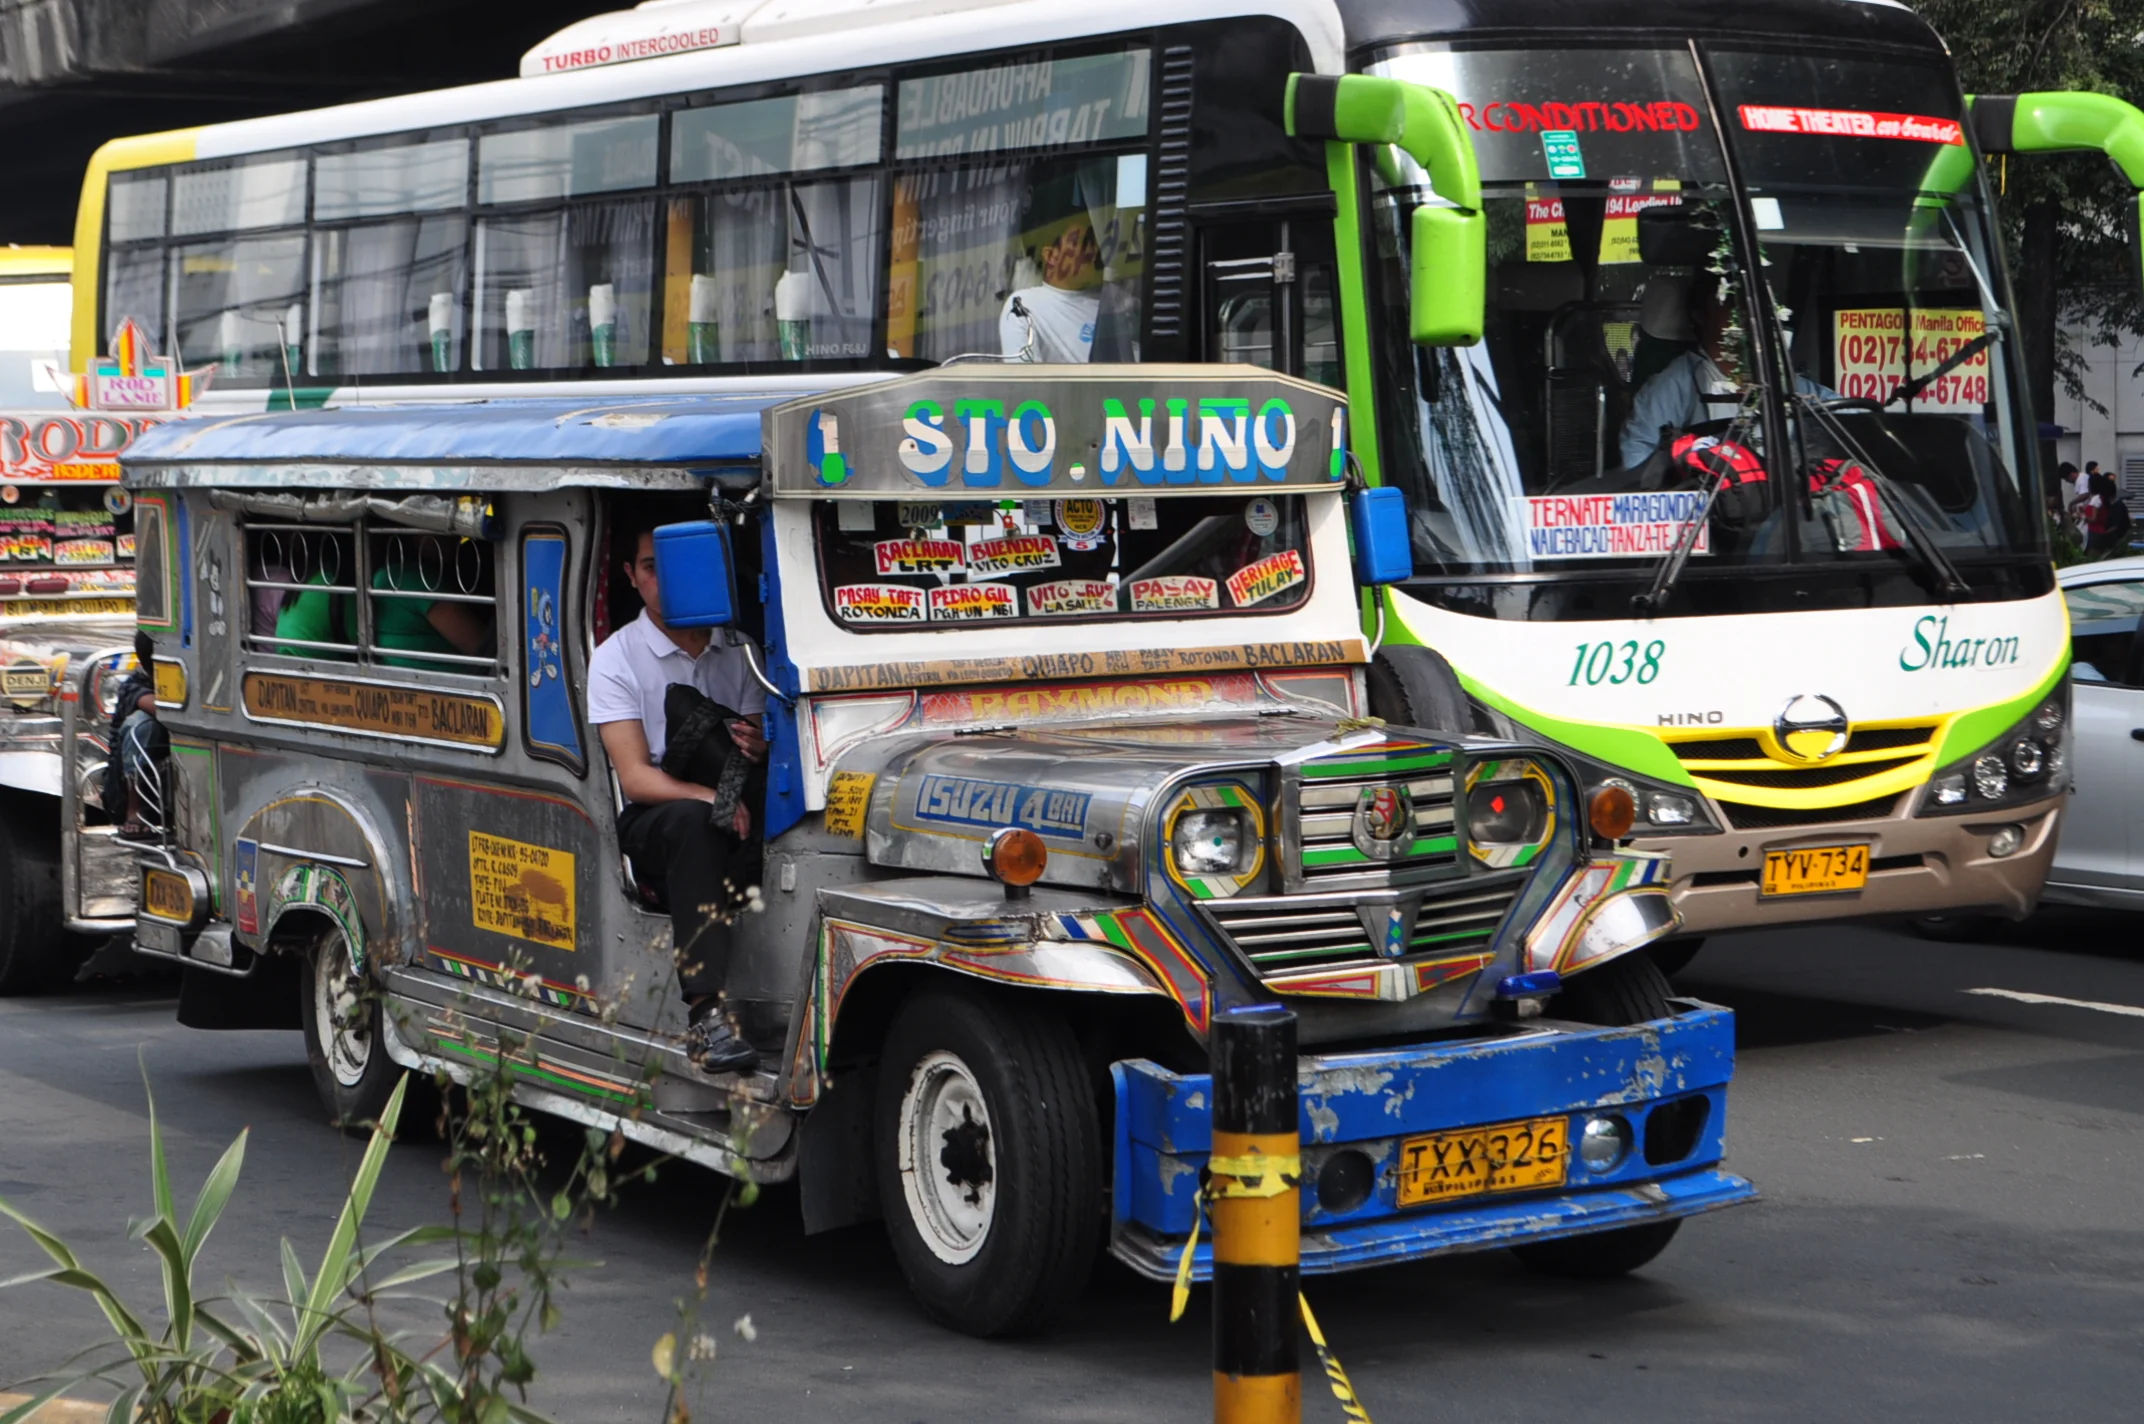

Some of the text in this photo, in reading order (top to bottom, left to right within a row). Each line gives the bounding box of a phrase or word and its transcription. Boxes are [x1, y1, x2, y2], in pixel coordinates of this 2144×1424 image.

[542, 27, 720, 72] TURBO INTERCOOLED
[1744, 107, 1798, 130] HOME
[1797, 111, 1876, 135] THEATER
[1529, 204, 1549, 219] The
[1916, 315, 1953, 332] Manila
[1956, 316, 1986, 332] Office
[805, 343, 840, 355] HINO
[110, 378, 155, 391] ROD
[902, 505, 938, 524] 2009
[1529, 495, 1613, 528] TERNATE
[876, 538, 964, 573] BACLARAN
[969, 537, 1056, 561] BUENDIA
[1075, 541, 1089, 550] 5
[898, 558, 954, 573] LRT
[974, 553, 1056, 573] VITO CRUZ
[1229, 549, 1304, 606] HERITAGE
[1246, 569, 1294, 602] TULAY
[837, 586, 923, 606] PASAY TAFT
[931, 586, 1013, 608] PEDRO GIL
[1029, 584, 1070, 611] VITO
[1135, 597, 1213, 610] PALENGKE
[841, 605, 921, 620] ROTONDA
[1178, 641, 1345, 667] ROTONDA BACLARAN
[1899, 615, 2020, 672] Sharon
[1021, 652, 1095, 677] QUIAPO
[1141, 660, 1171, 671] TAFT
[1565, 639, 1666, 687] 1038
[816, 661, 901, 691] DAPITAN
[258, 680, 297, 713] DAPITAN
[356, 689, 390, 724] QUIAPO
[971, 680, 1213, 721] RAYMOND
[431, 697, 488, 739] BACLARAN
[1657, 710, 1724, 726] HINO
[919, 777, 1020, 824] ISUZU
